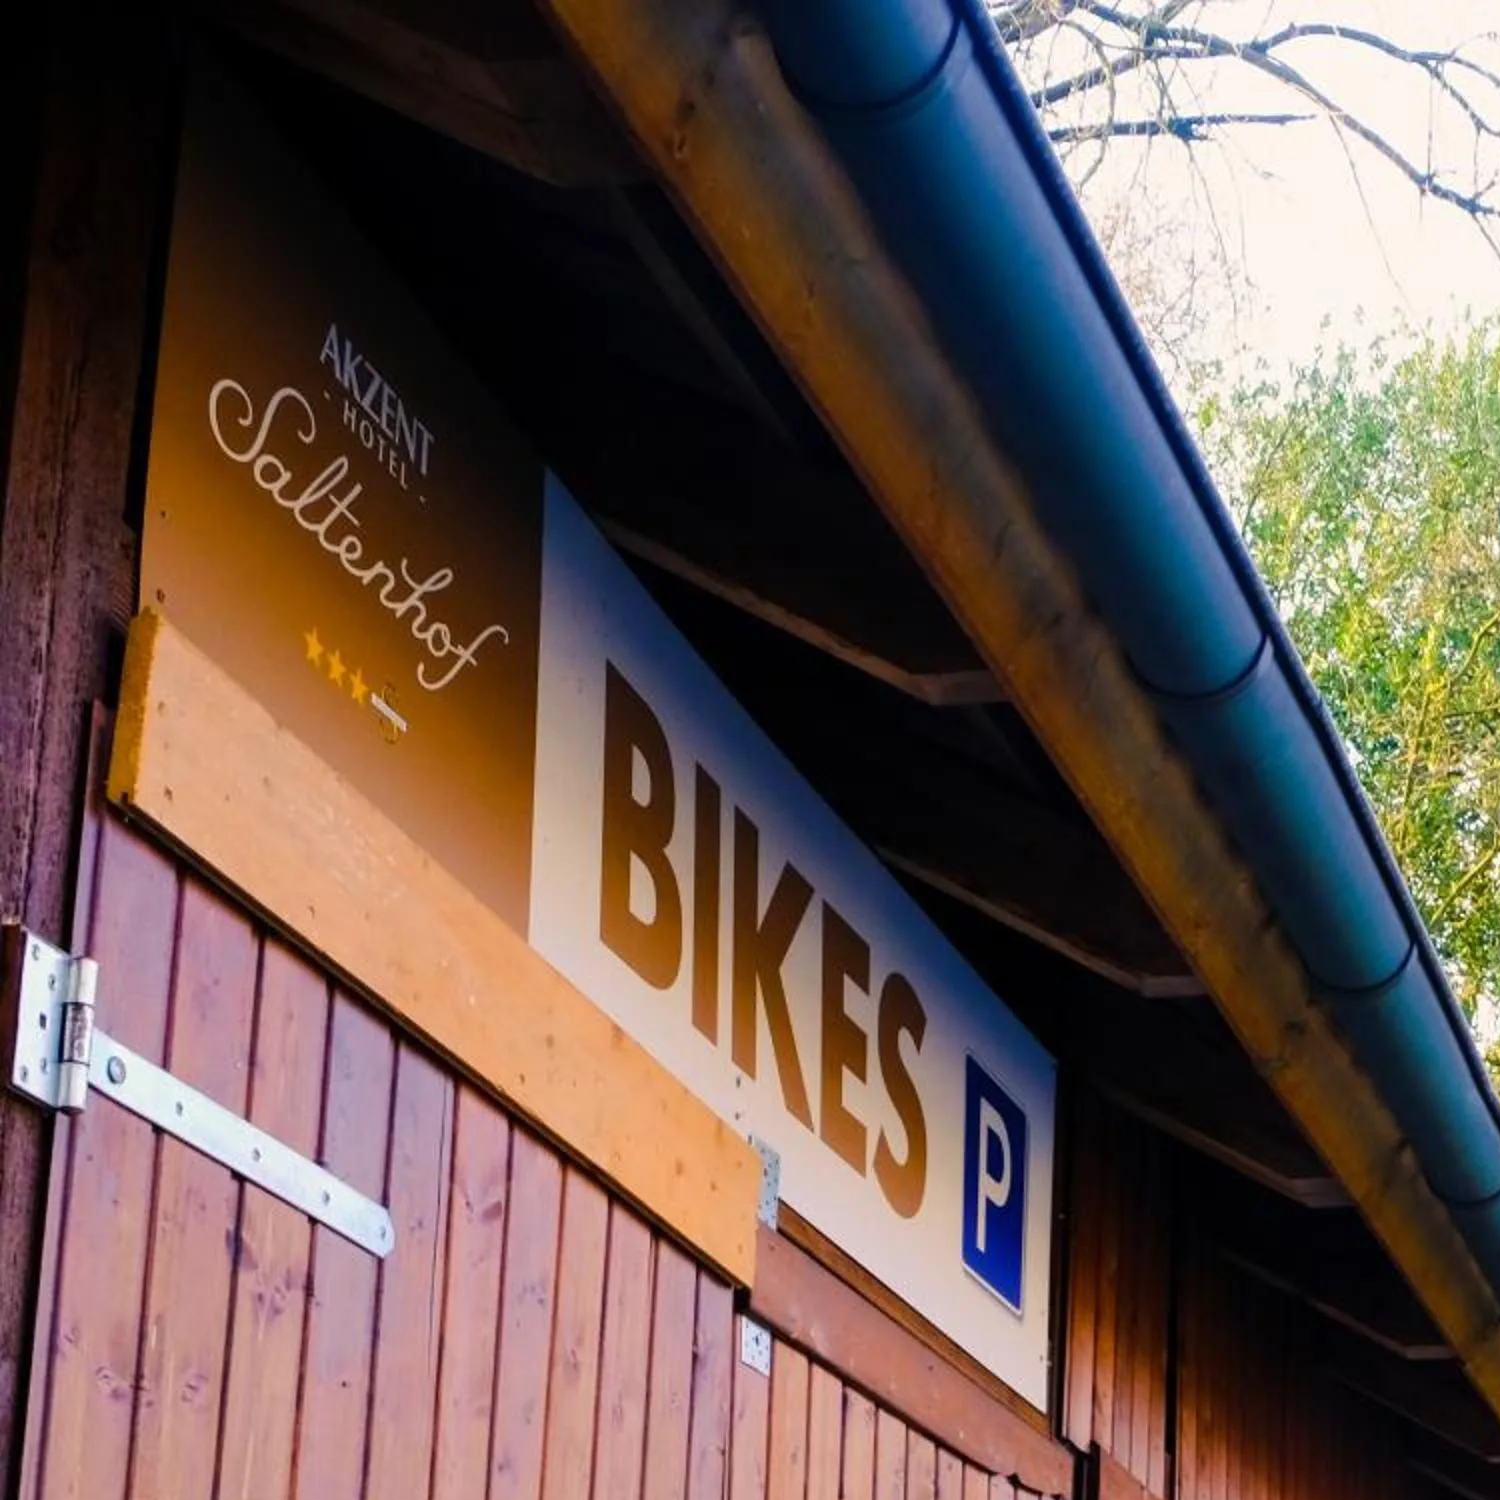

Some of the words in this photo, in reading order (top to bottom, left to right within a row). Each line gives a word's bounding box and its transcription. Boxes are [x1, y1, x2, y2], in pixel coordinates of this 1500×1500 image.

[320, 322, 435, 476] AKZENT
[343, 399, 409, 490] HOTEL
[209, 378, 510, 692] Saltenhof
[599, 658, 930, 1220] BIKES
[976, 1096, 1012, 1254] P
